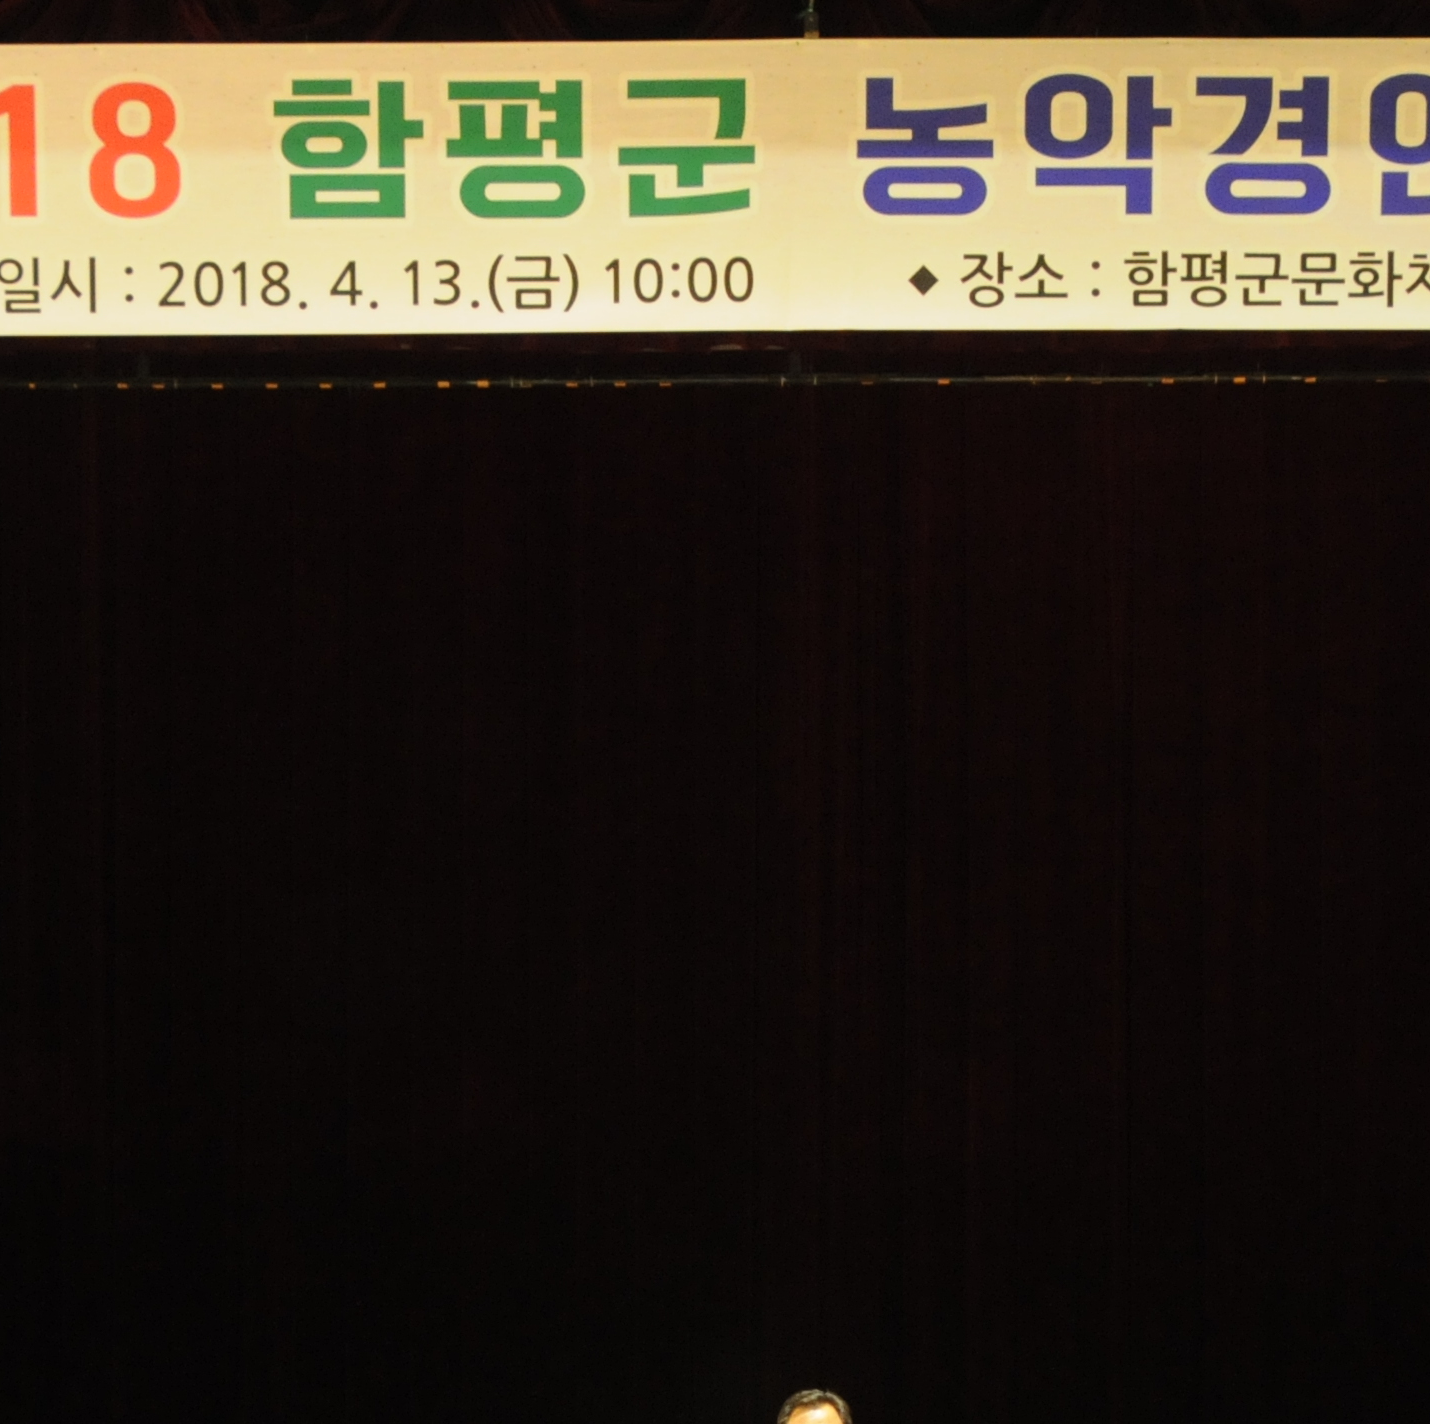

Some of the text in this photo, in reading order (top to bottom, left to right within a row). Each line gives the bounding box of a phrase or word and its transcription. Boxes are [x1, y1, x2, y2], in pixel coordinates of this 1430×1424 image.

[272, 78, 756, 218] 함평군
[159, 261, 307, 309] 2018.
[330, 261, 379, 309] 4.
[606, 257, 754, 303] 10:00
[961, 251, 1067, 308] 장소
